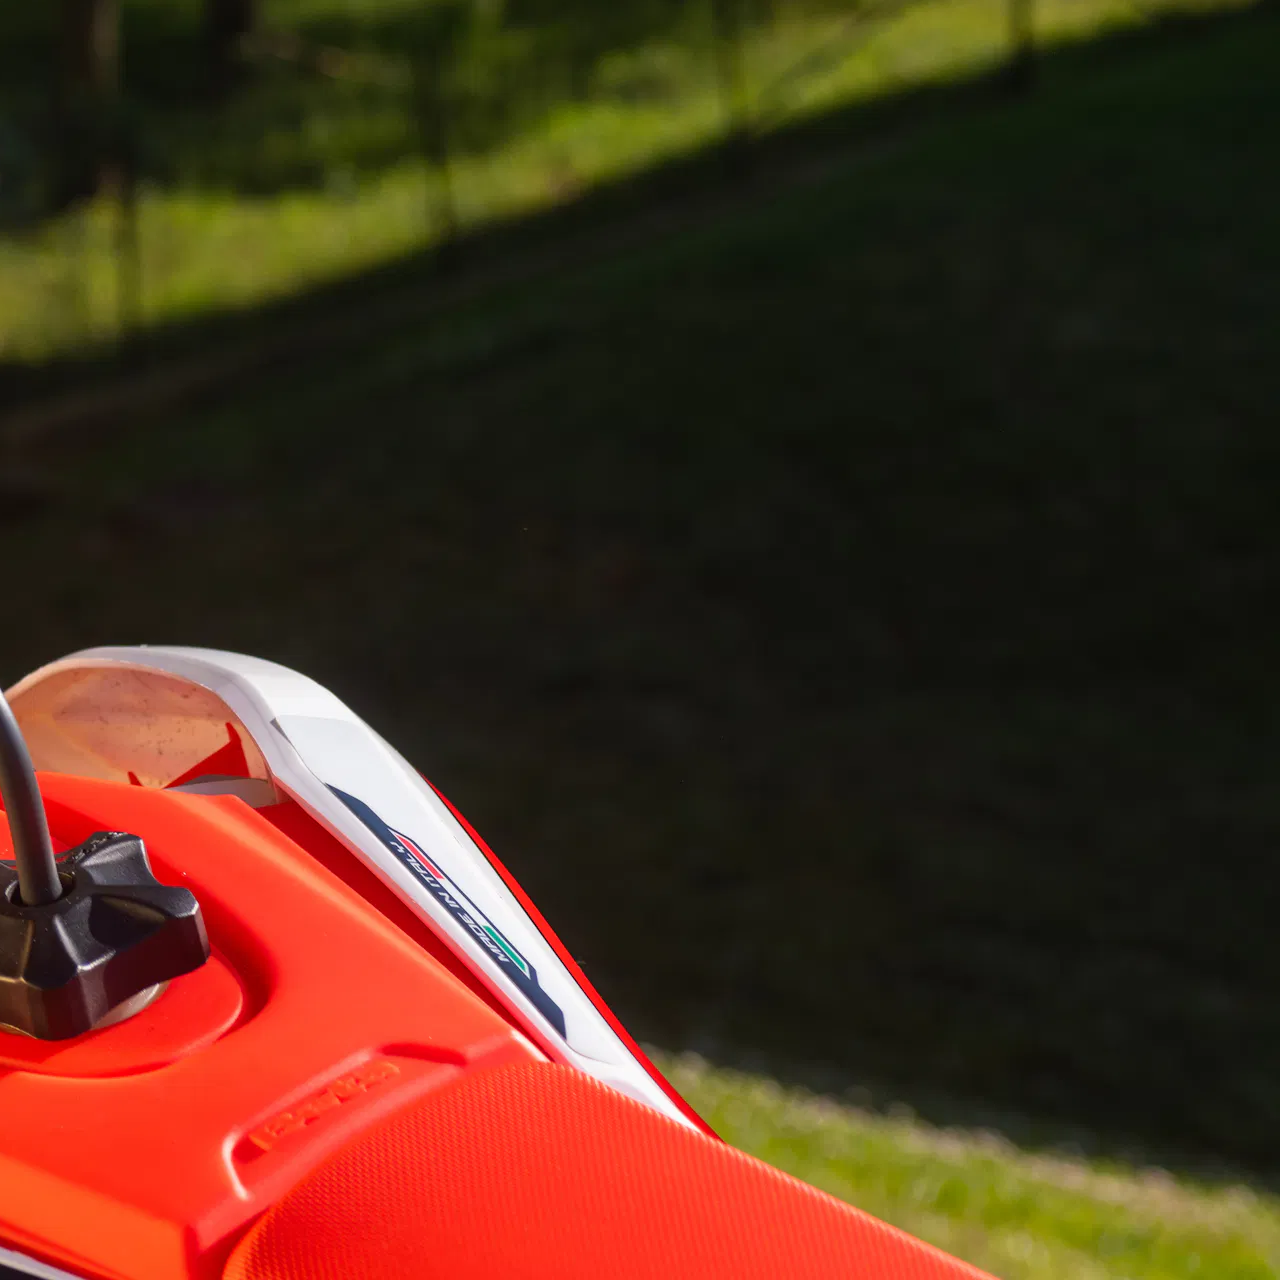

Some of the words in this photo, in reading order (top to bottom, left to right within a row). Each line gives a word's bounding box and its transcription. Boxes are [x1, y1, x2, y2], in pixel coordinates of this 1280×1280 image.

[389, 840, 441, 888] ITALY
[438, 892, 461, 909] IN
[457, 911, 511, 963] MADE
